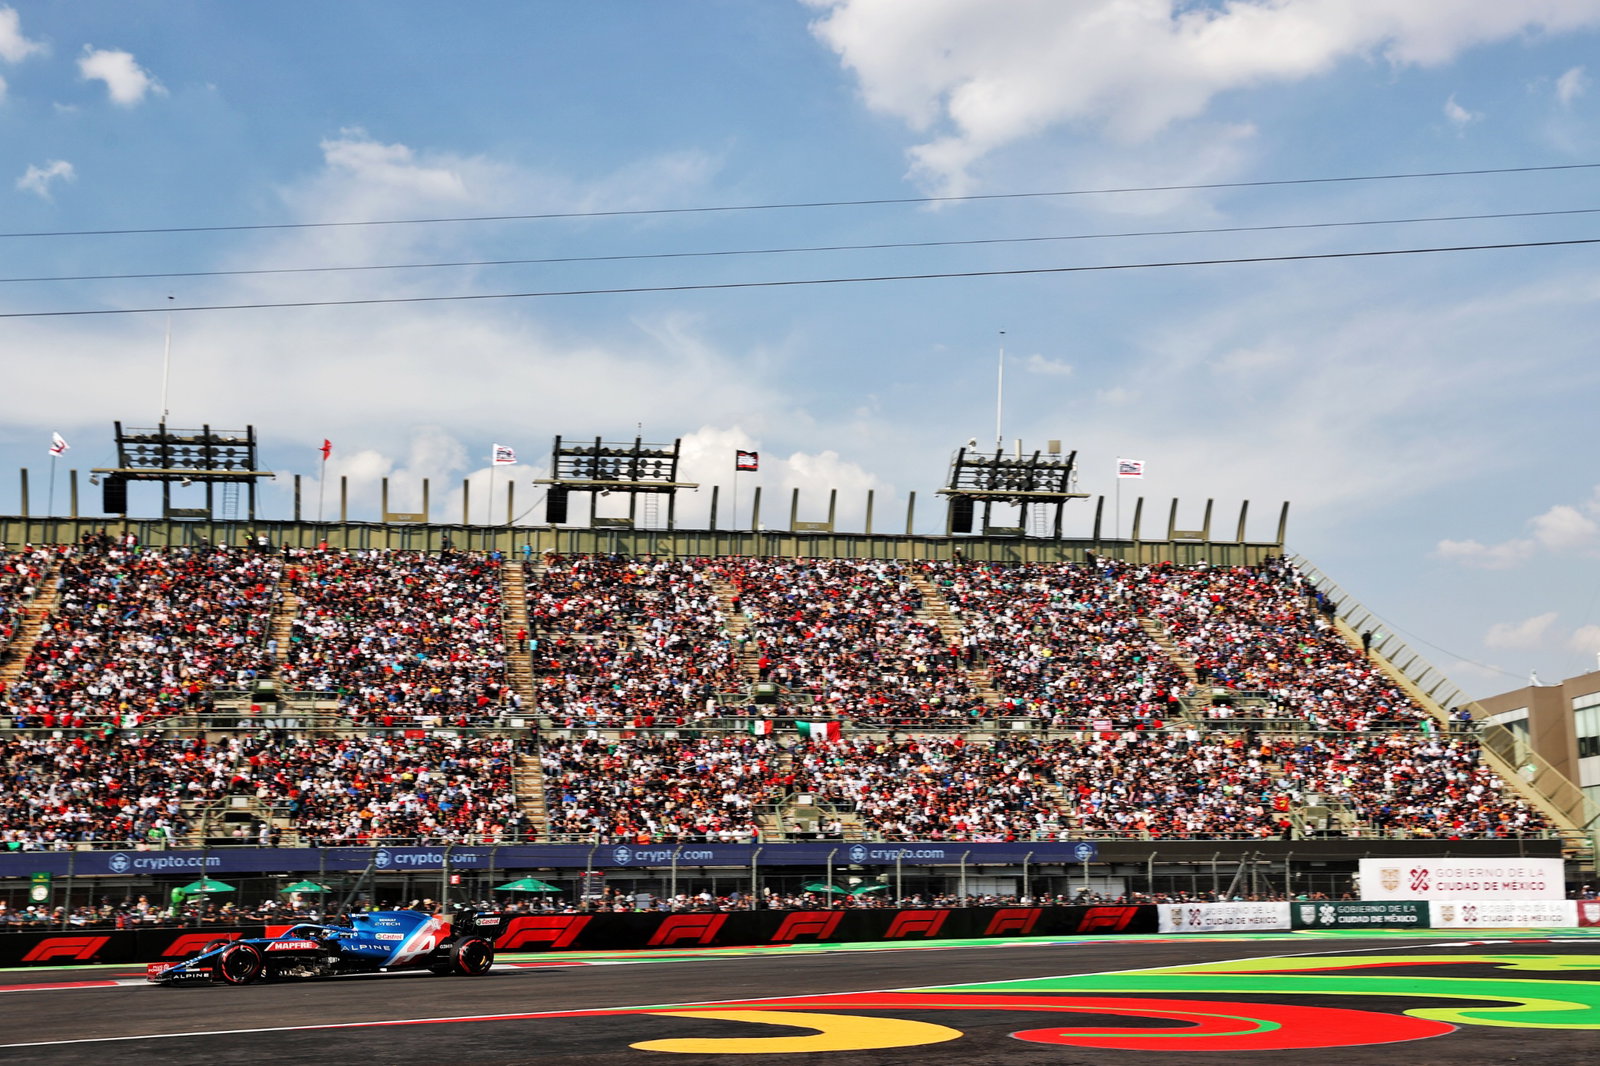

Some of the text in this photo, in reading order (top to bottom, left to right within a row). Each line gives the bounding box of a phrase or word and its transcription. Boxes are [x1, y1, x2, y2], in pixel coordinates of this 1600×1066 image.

[1435, 868, 1544, 878] GOBIERNO DE LA
[1436, 880, 1546, 891] CIUDAD DE MÉXICO
[1337, 905, 1386, 913] GOBIERNO
[1205, 917, 1233, 925] CIUDAD
[1235, 917, 1246, 925] DE
[1337, 913, 1418, 923] CIUDAD DE MÉXICO
[1481, 914, 1514, 922] CIUDAD
[1516, 914, 1528, 922] DE
[274, 942, 313, 950] MAPFRE
[340, 944, 392, 952] ALPINE
[173, 972, 210, 980] ALPINE
